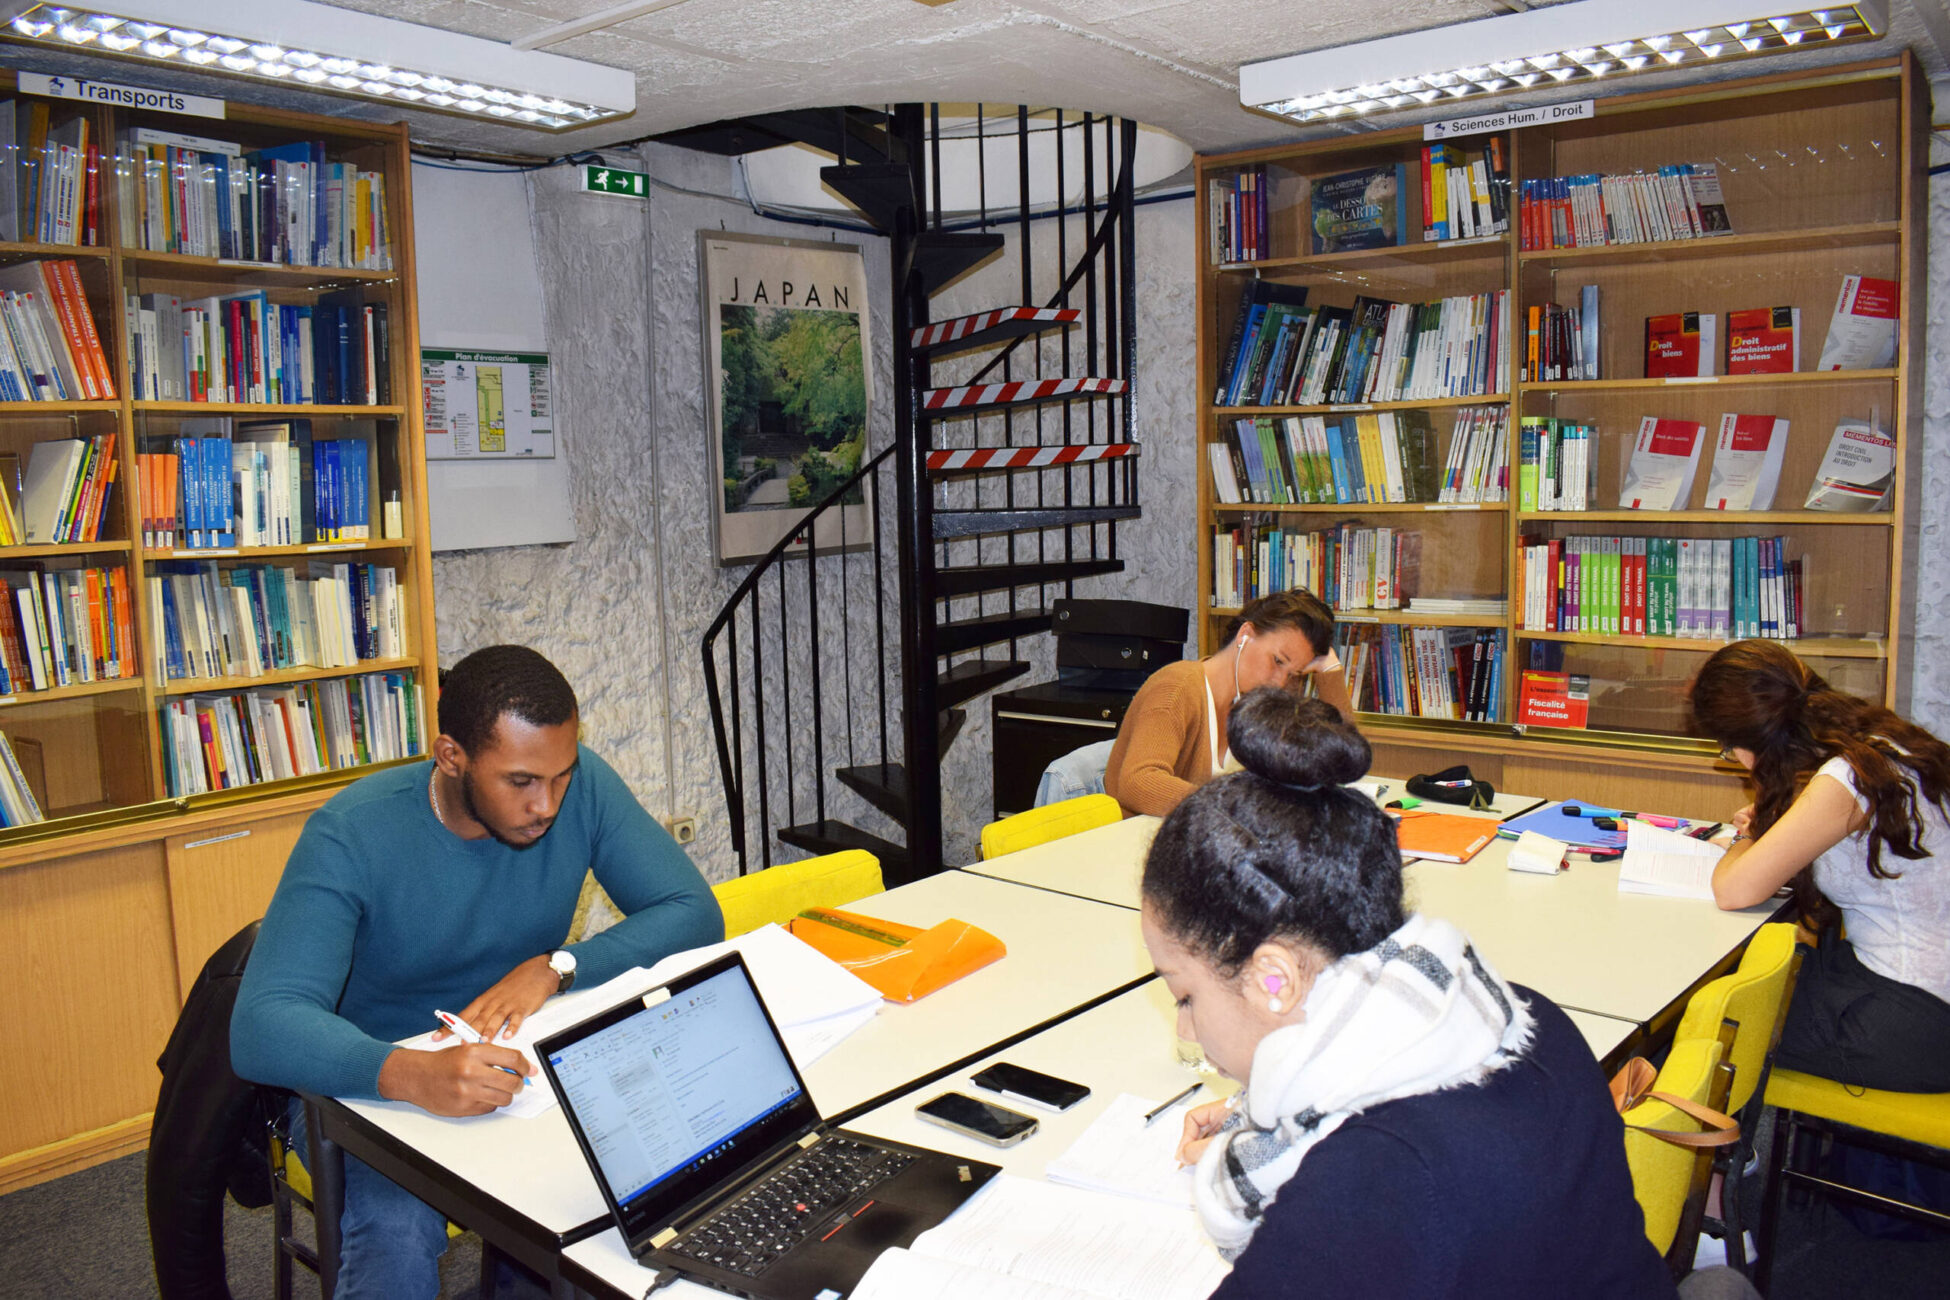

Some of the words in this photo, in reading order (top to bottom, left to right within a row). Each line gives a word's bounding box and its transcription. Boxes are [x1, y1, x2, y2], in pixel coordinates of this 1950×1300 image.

[74, 79, 185, 110] Transports
[1452, 118, 1504, 132] Sciences
[1508, 114, 1539, 125] Hum.
[1553, 104, 1583, 118] Droit
[1342, 203, 1383, 222] CARTES
[730, 277, 849, 309] JAPAN
[1650, 340, 1673, 352] Droit
[1732, 336, 1759, 348] Droit
[1662, 349, 1683, 358] biens
[1731, 343, 1787, 354] administratif
[455, 352, 473, 361] Plan
[1731, 354, 1746, 362] des
[1748, 353, 1771, 361] biens
[1377, 577, 1387, 599] CV
[1529, 698, 1566, 709] Fiscalité
[1528, 708, 1569, 719] française
